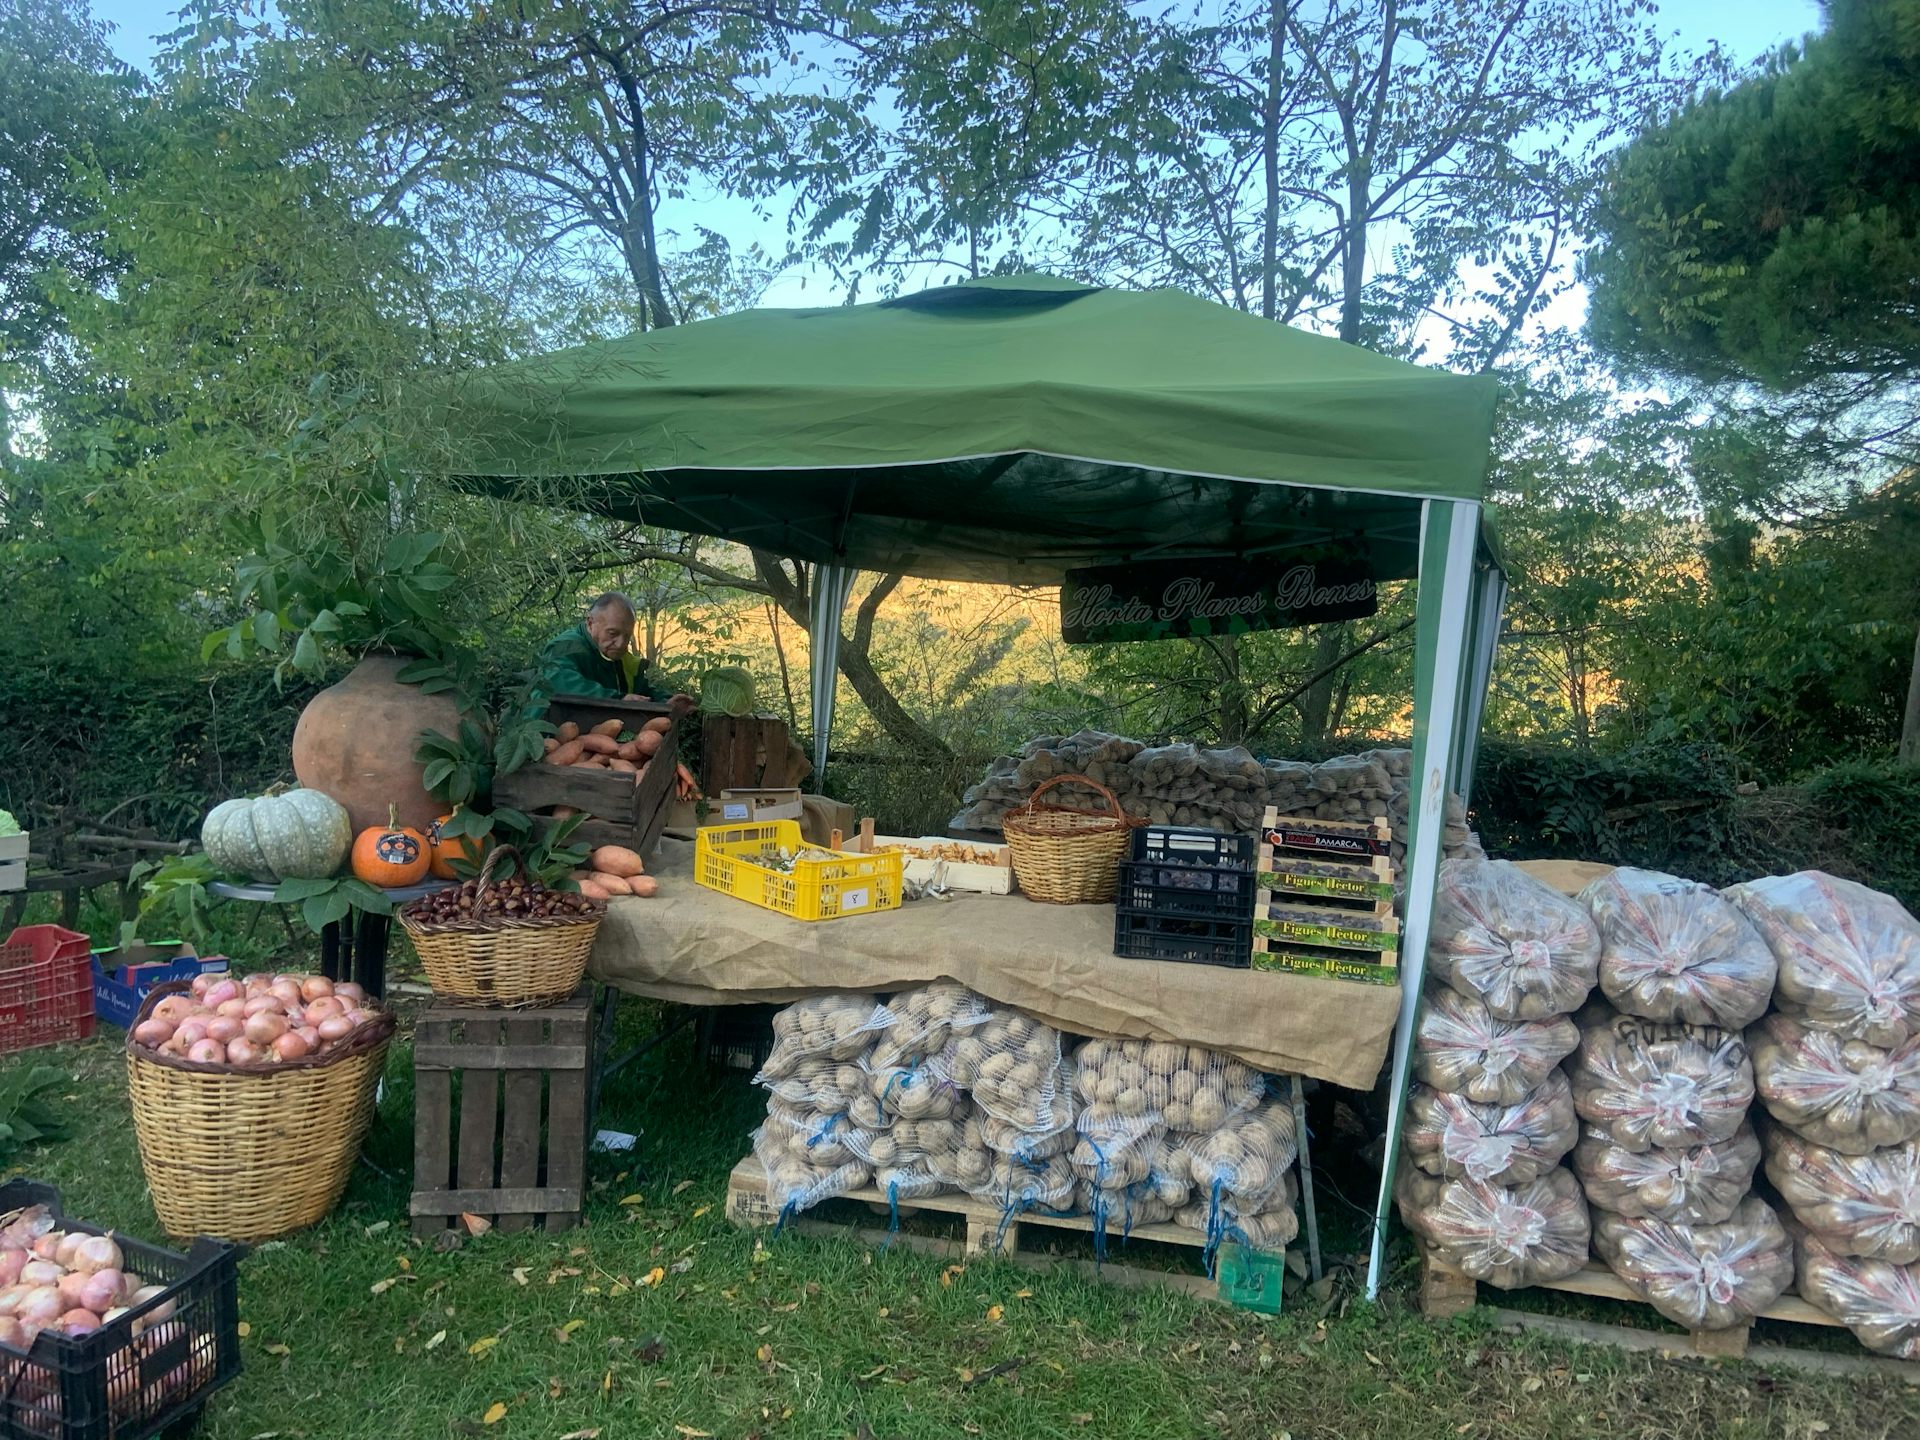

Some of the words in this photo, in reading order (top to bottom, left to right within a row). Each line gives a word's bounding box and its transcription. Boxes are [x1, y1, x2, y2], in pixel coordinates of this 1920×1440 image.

[1063, 584, 1153, 628] Horta
[1158, 577, 1266, 620] Planes
[1275, 565, 1375, 609] Bones
[1285, 874, 1322, 887] Figues
[1283, 922, 1321, 937] Figues
[1282, 956, 1321, 970] Figues
